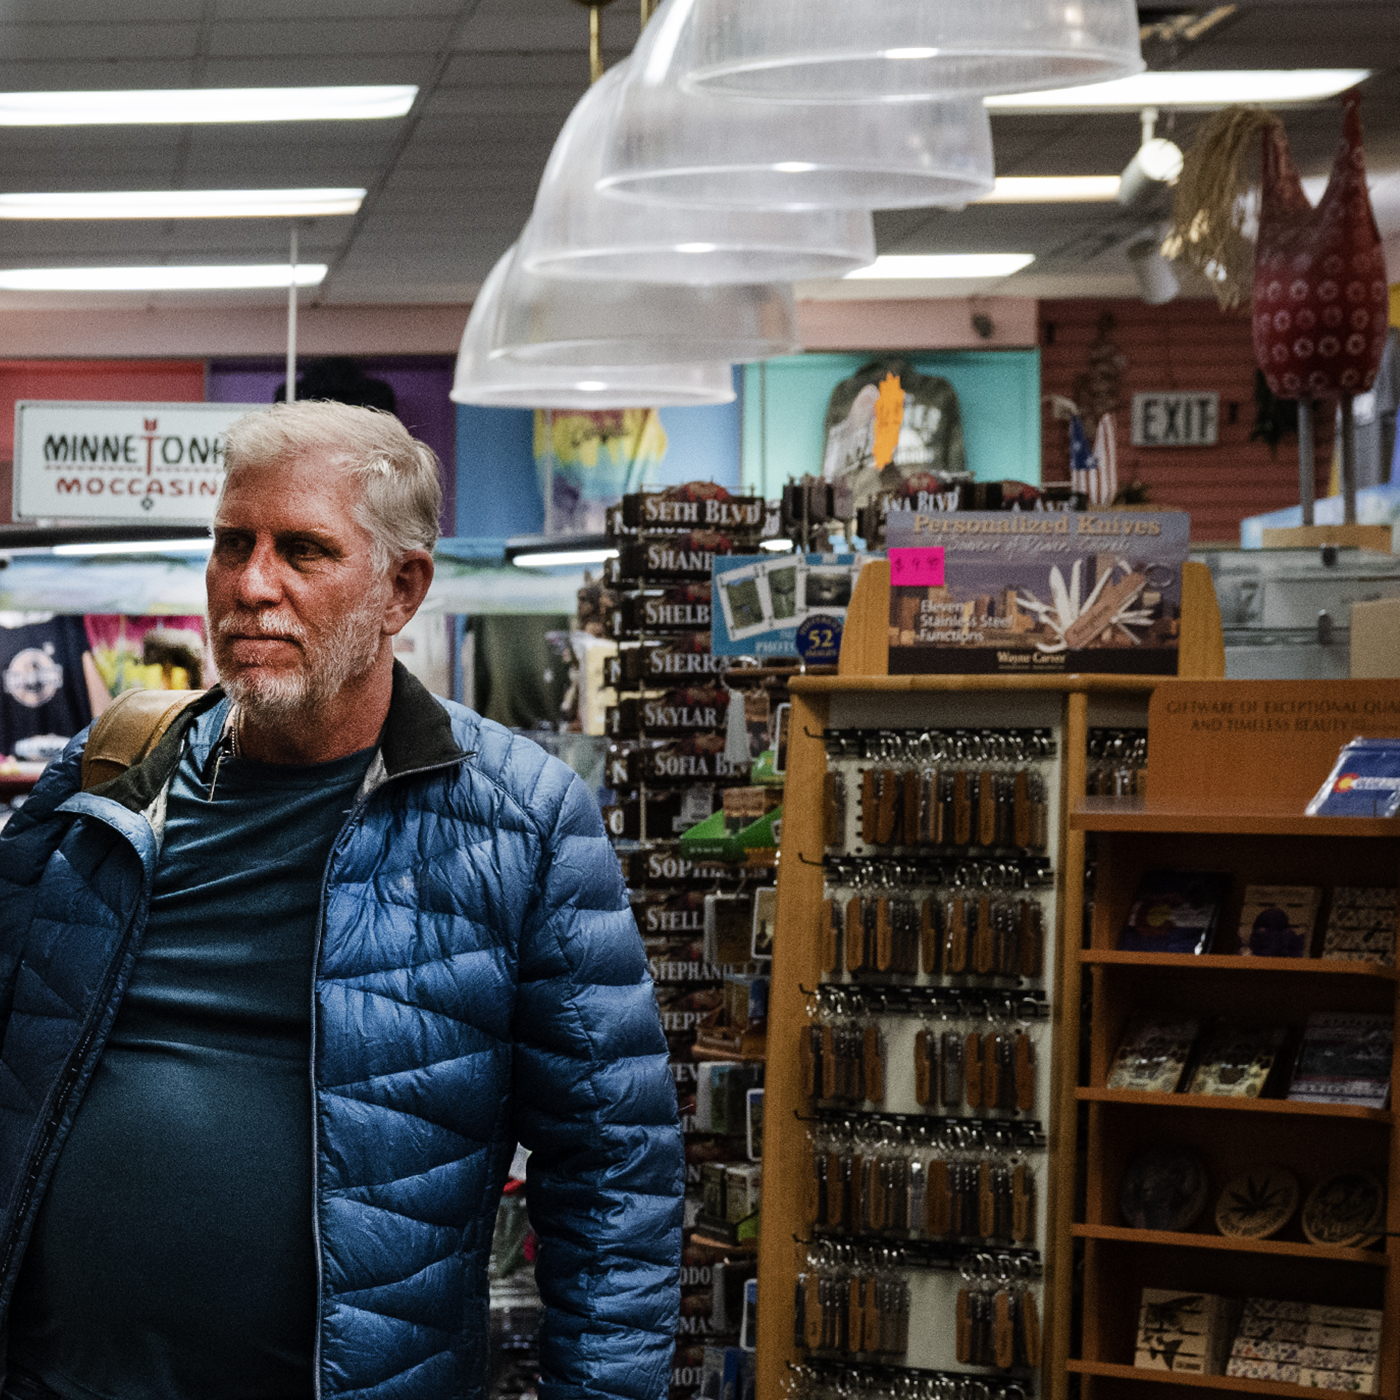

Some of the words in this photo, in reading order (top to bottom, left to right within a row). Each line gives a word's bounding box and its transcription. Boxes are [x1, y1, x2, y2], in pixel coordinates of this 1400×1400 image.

[1142, 400, 1216, 444] EXIT
[644, 498, 699, 524] SETH
[705, 498, 762, 525] BLVD
[913, 513, 1069, 535] Personalized
[1077, 514, 1162, 537] Knives
[919, 599, 963, 615] Eleven
[919, 613, 977, 629] Stainless
[979, 614, 1014, 629] Steel
[808, 629, 834, 650] 52
[919, 628, 985, 644] Functions
[644, 703, 717, 728] SKYLAR
[654, 751, 709, 777] SOFIA
